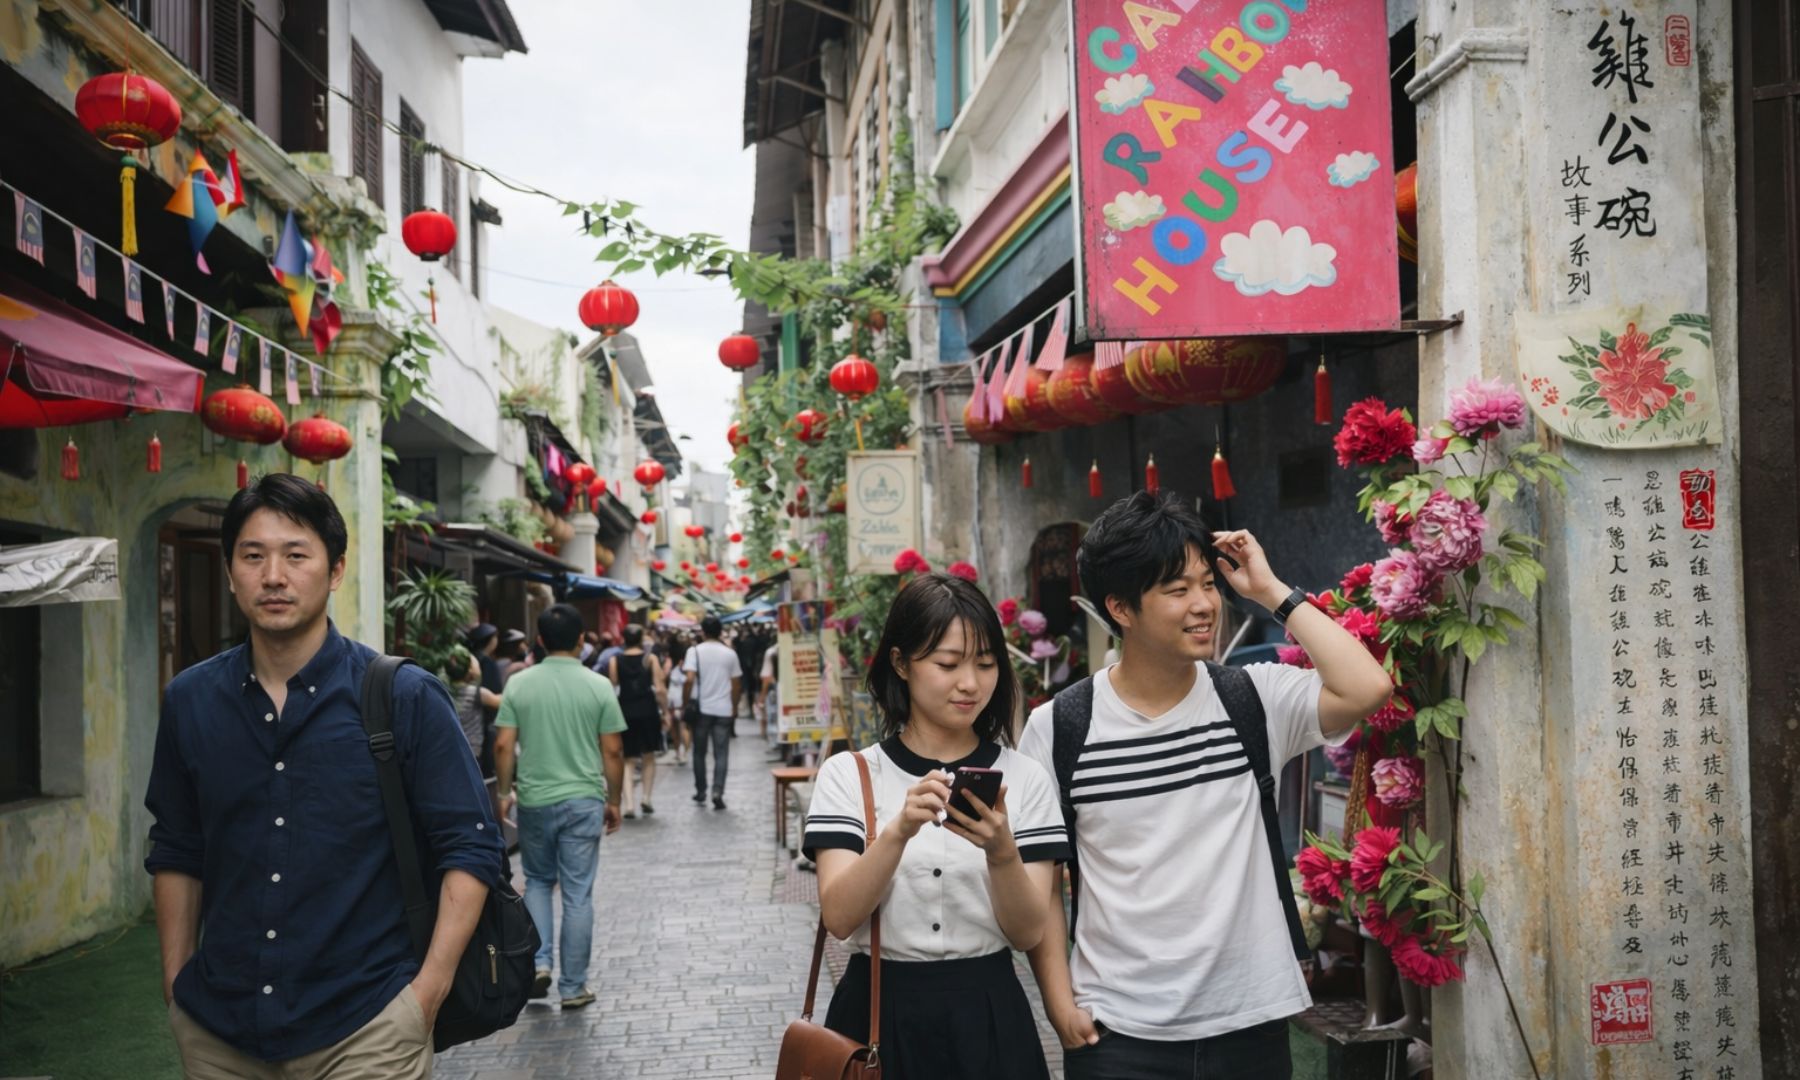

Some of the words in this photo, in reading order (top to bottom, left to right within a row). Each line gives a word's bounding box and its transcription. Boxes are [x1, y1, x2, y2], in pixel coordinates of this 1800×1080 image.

[1088, 0, 1200, 73] CA
[1112, 98, 1309, 316] HOUSE
[1560, 155, 1592, 295] 故事系列
